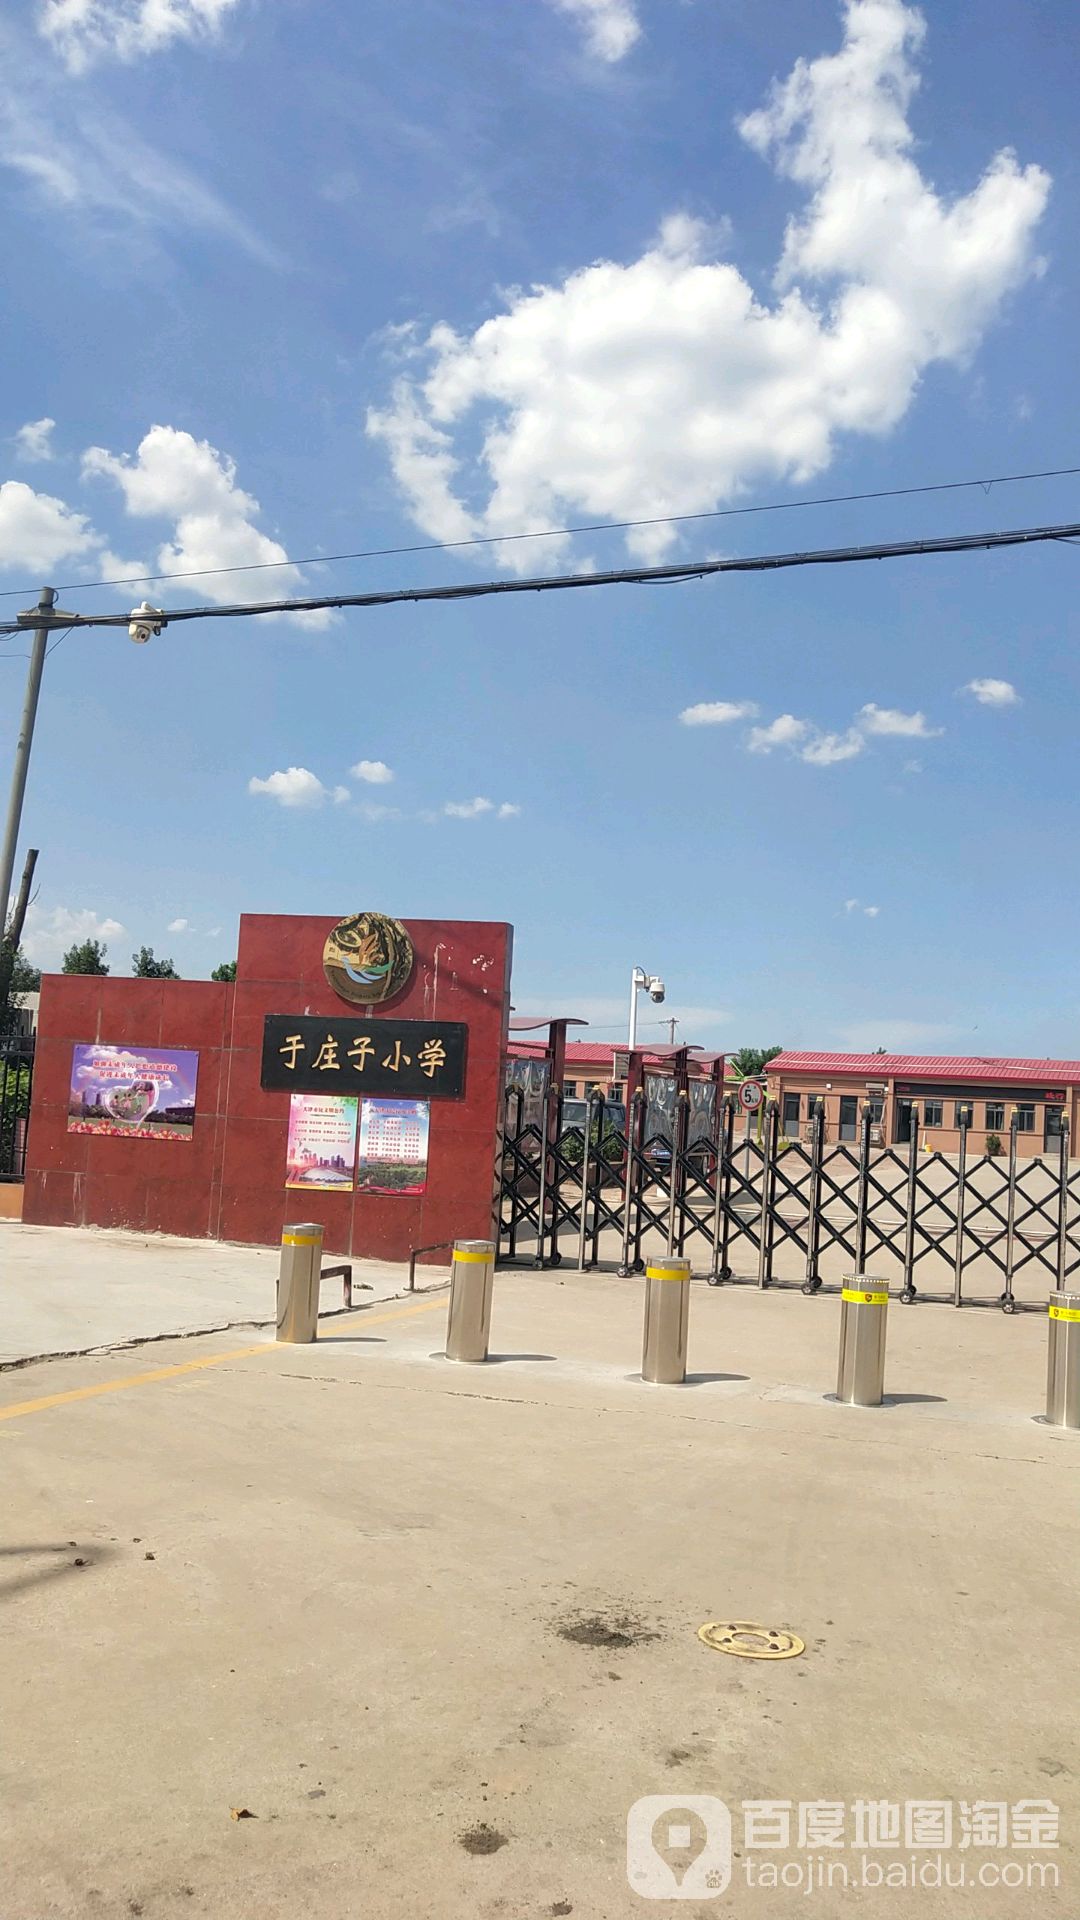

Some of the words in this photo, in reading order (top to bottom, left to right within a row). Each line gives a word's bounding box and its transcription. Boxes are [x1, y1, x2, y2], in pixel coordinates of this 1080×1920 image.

[279, 1033, 447, 1078] 于庄子小学
